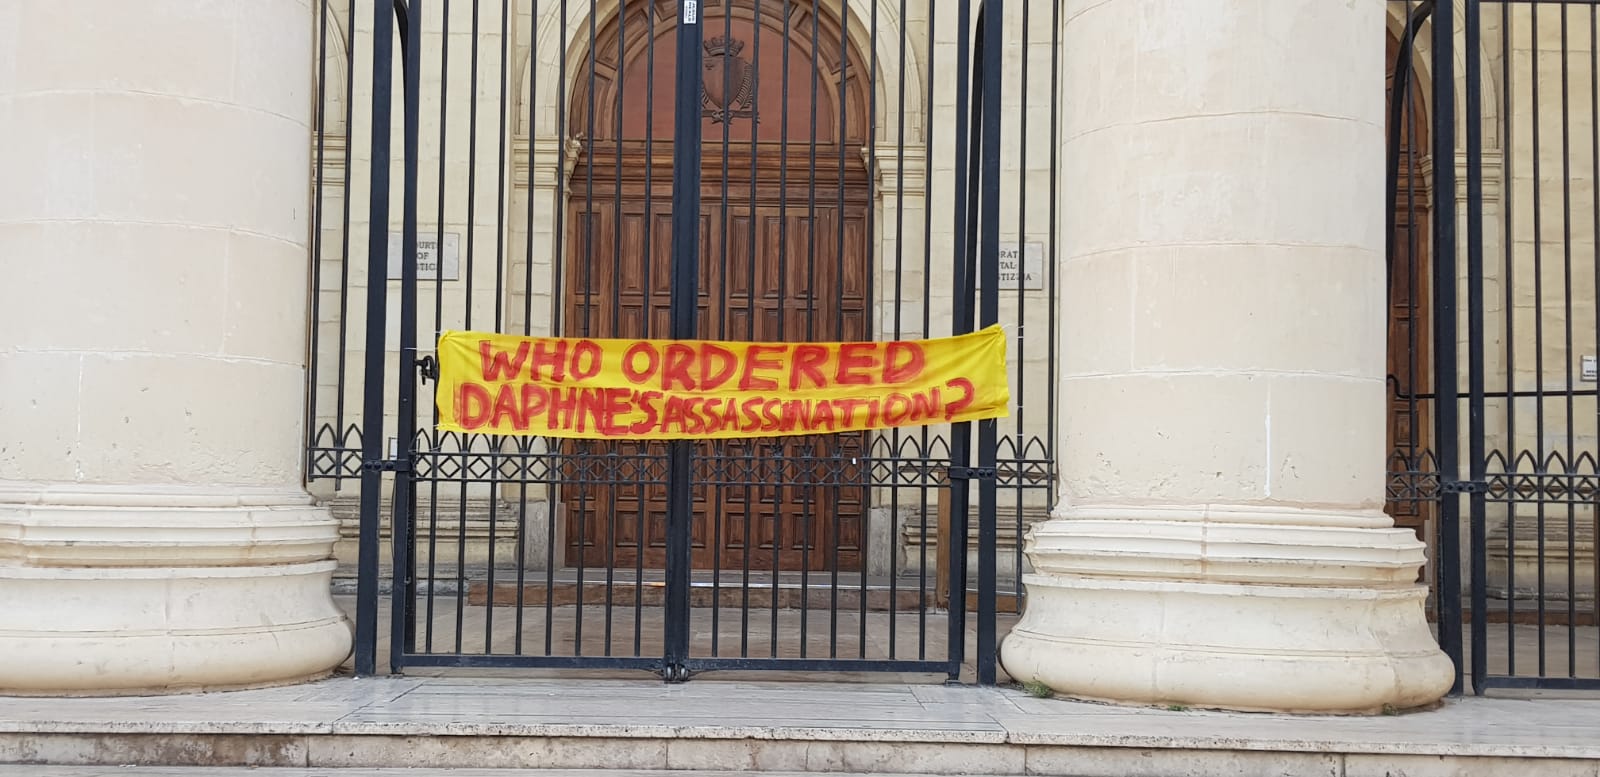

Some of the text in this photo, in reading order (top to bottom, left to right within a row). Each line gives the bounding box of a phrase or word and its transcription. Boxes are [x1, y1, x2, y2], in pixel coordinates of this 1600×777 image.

[478, 339, 926, 391] WHO ORDERED
[454, 377, 975, 435] DAPHNE'S ASSASSINATION?
